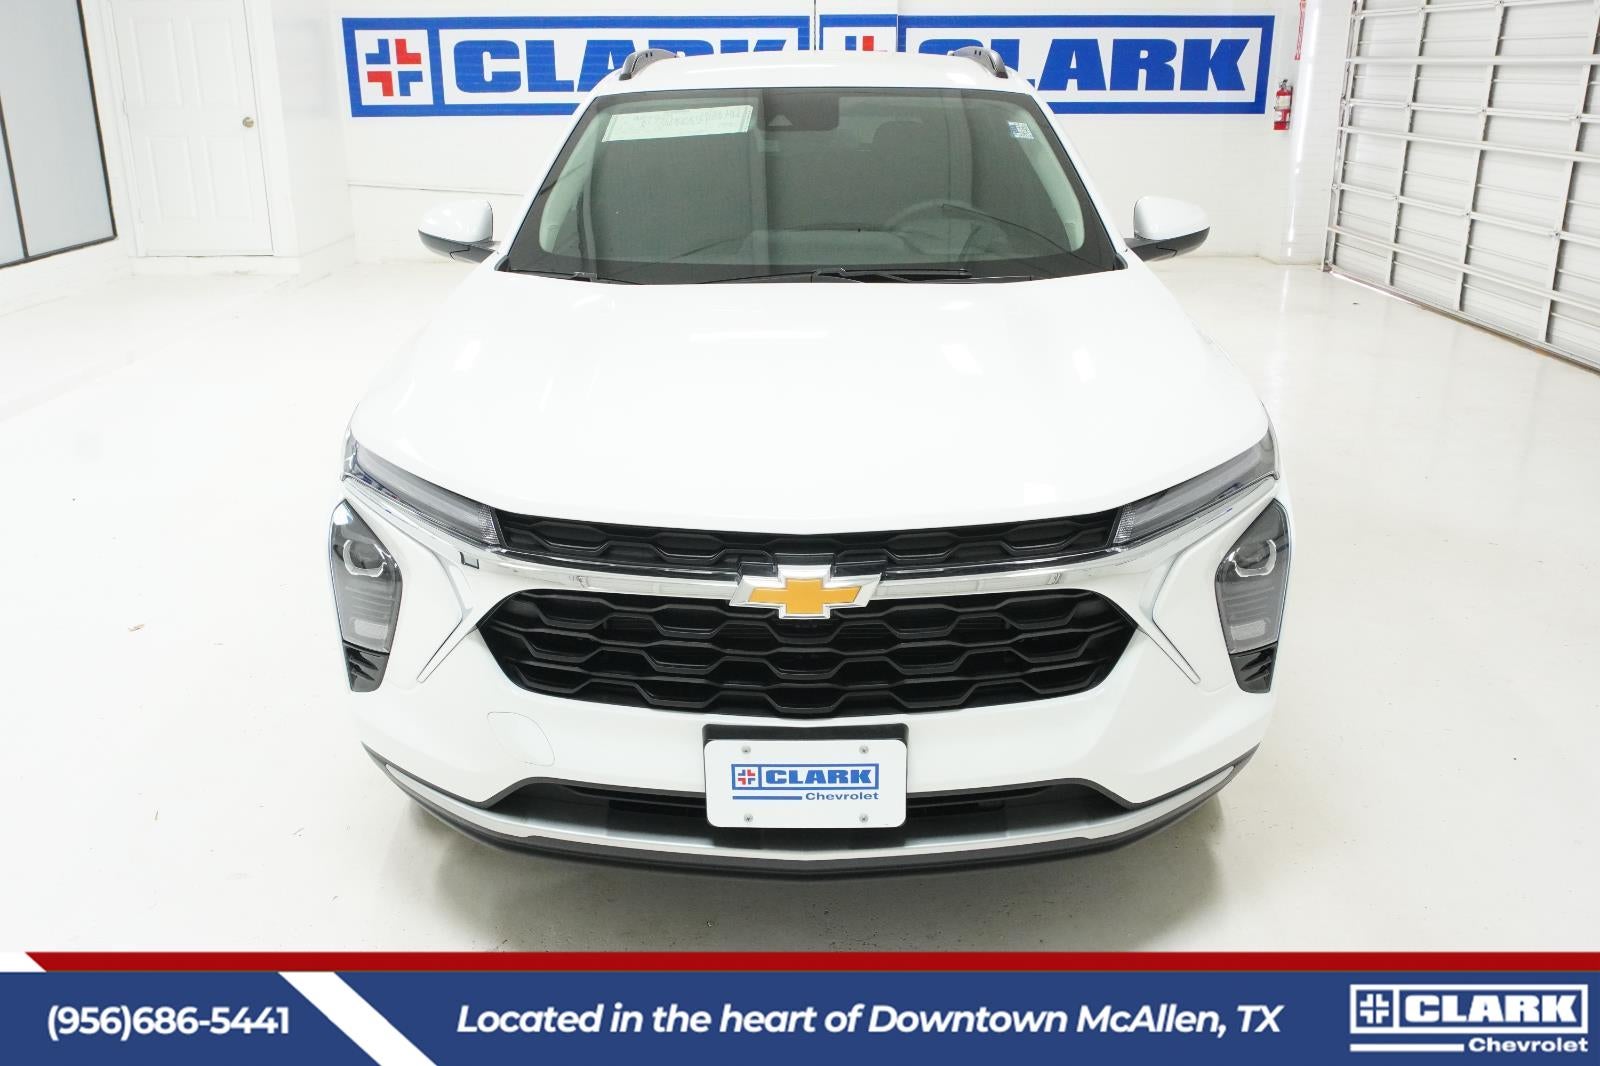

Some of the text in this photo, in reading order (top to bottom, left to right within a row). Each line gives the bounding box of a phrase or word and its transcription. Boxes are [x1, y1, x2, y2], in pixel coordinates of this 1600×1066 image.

[453, 39, 786, 93] CLA
[765, 770, 871, 785] CLARK
[804, 791, 879, 801] Chevrolet
